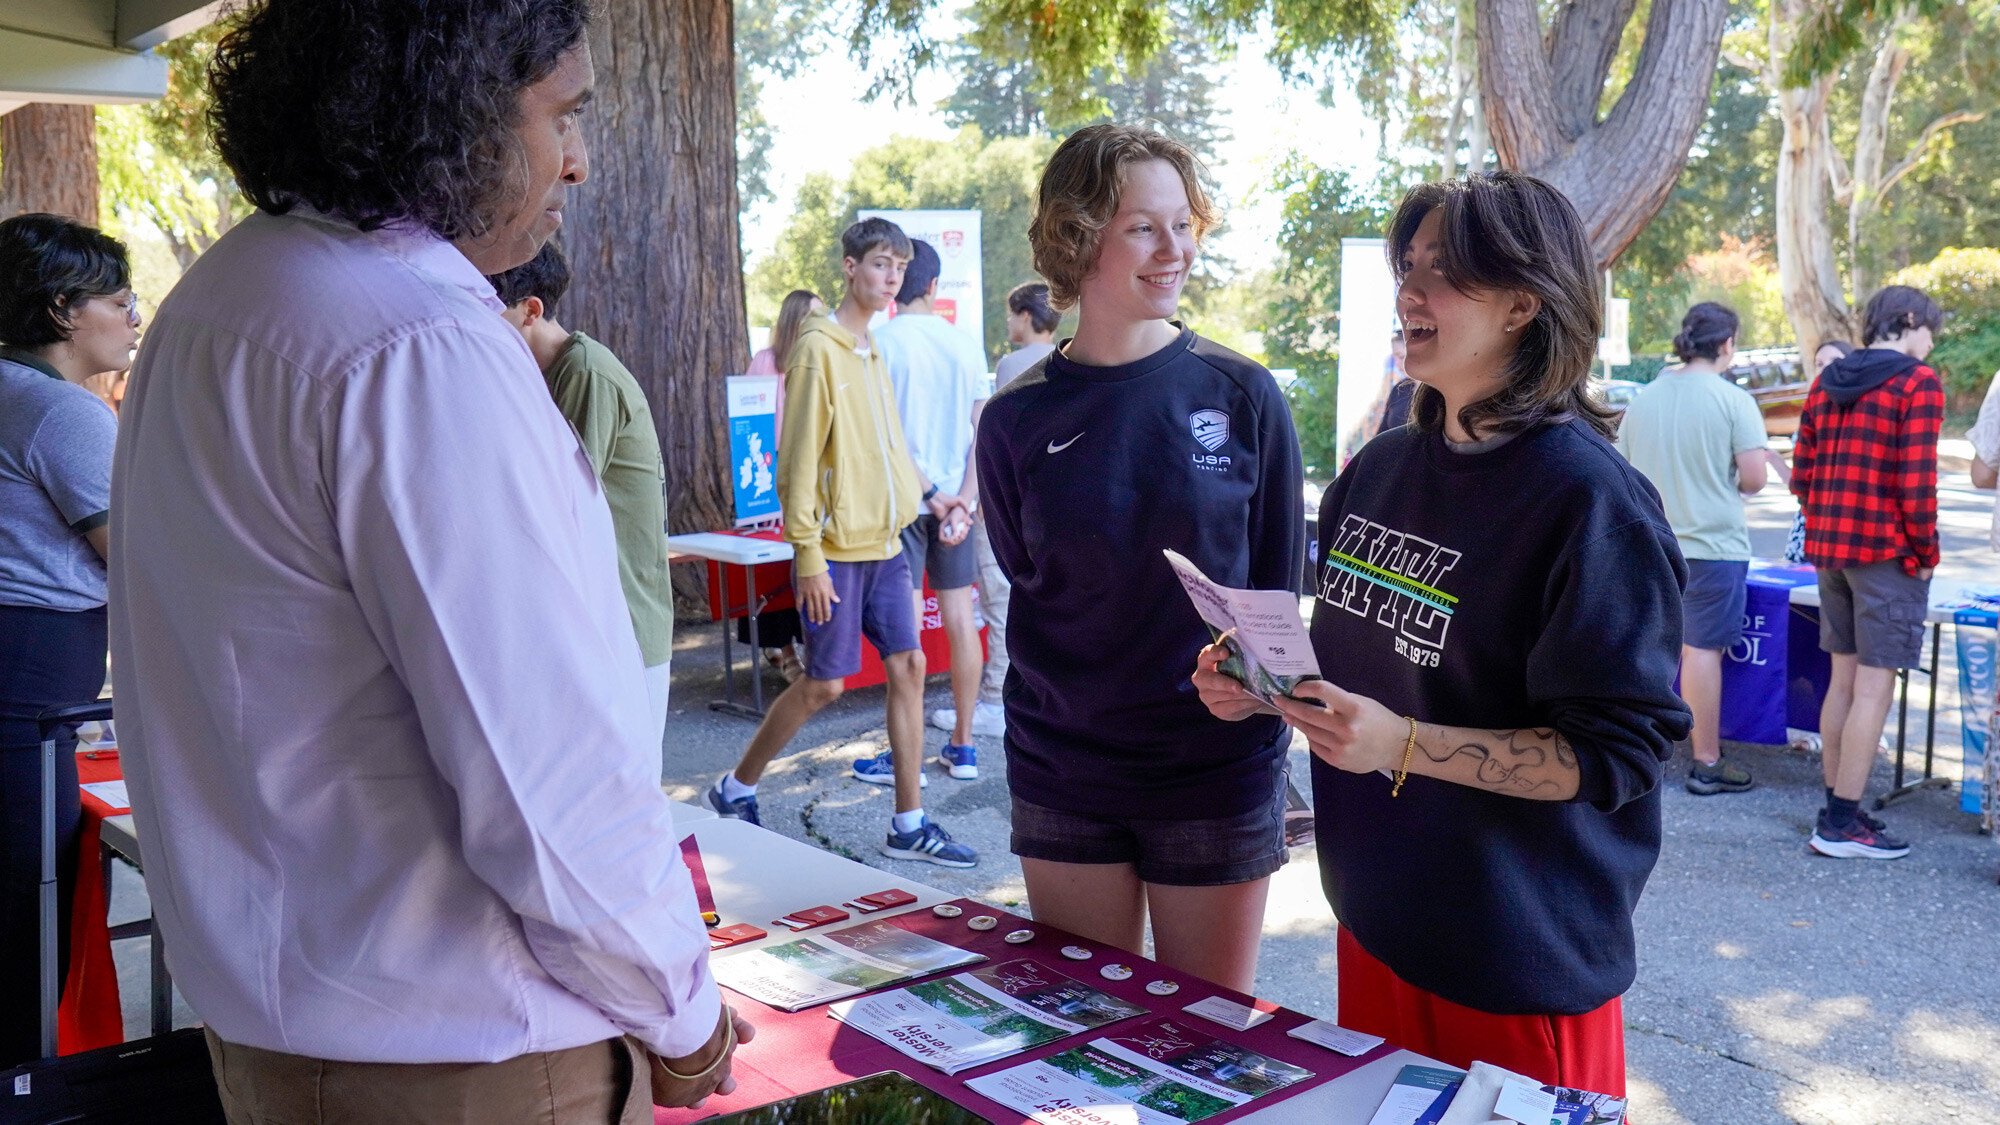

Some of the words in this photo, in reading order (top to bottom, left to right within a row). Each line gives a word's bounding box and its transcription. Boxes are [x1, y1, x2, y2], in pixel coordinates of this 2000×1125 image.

[1192, 453, 1231, 465] USA
[1350, 560, 1377, 578] VALLEY
[1420, 588, 1451, 608] SCHOOL
[945, 983, 965, 996] World
[964, 994, 990, 1008] Brighter
[1014, 1003, 1042, 1017] Canada
[1083, 1051, 1108, 1064] World
[1098, 1064, 1128, 1079] Building
[1106, 1060, 1138, 1076] Brighter
[1003, 1077, 1022, 1088] Guide
[1164, 1068, 1198, 1084] Canada
[998, 1082, 1038, 1101] International
[1199, 1081, 1239, 1099] Hamilton,
[1033, 1103, 1087, 1125] aster
[1049, 1098, 1117, 1125] versity
